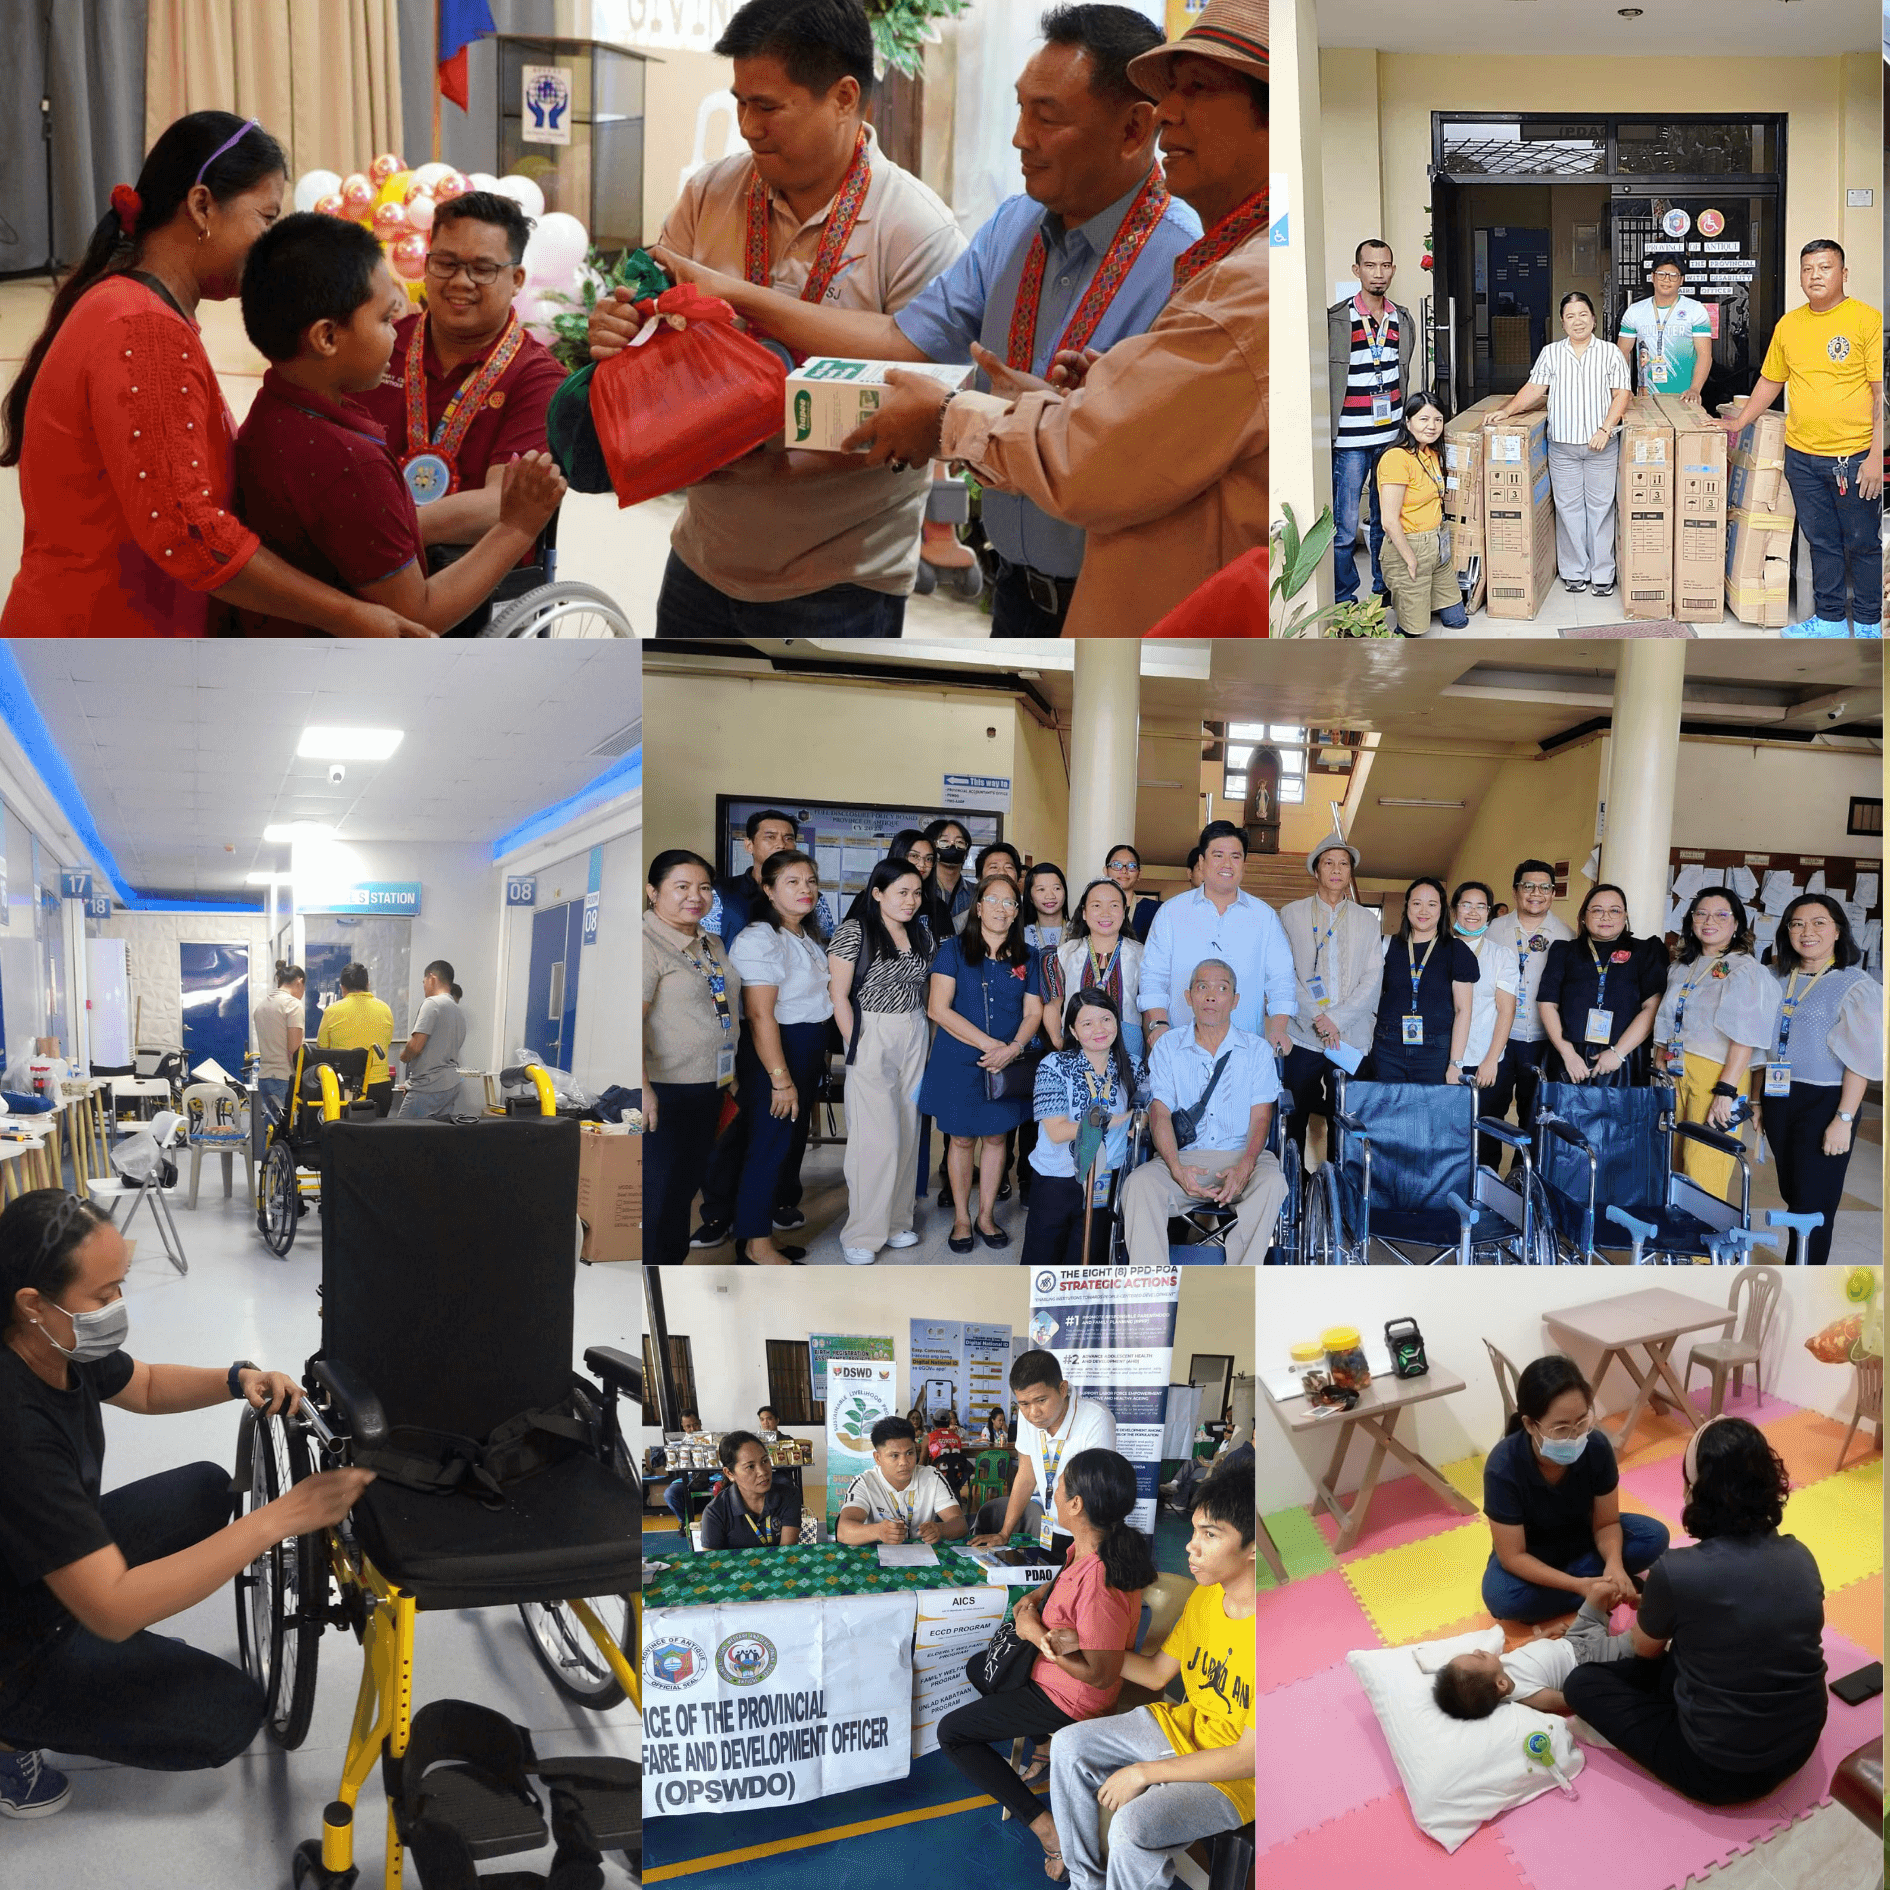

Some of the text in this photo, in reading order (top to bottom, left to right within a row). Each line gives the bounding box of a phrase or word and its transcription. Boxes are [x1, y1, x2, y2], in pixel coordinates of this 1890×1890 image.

[1646, 242, 1740, 251] PROVINCE OF ANTIQUE
[969, 777, 985, 786] This
[985, 779, 1000, 788] way
[69, 875, 86, 893] 17
[370, 892, 415, 905] STATION
[510, 883, 532, 901] 08
[91, 899, 106, 914] 18
[585, 908, 597, 933] 08
[1060, 1266, 1178, 1279] THE EIGHT (8) PPD-POA
[1059, 1276, 1178, 1292] STRATEGIC ACTIONS
[1065, 1315, 1079, 1327] #1
[1063, 1354, 1080, 1365] #2
[843, 1367, 872, 1378] DSWD
[849, 1389, 883, 1404] LIVELIHOOD
[832, 1394, 848, 1432] SUSTAINABLE
[1025, 1569, 1053, 1582] PDAO
[952, 1596, 976, 1606] AICS
[930, 1622, 991, 1637] ECCD PROGRAM
[680, 1638, 706, 1662] ANTIQUE
[930, 1673, 961, 1688] PROGRAM
[940, 1686, 972, 1703] KABATAAN
[676, 1703, 698, 1736] OF
[700, 1700, 734, 1734] THE
[737, 1690, 828, 1731] PROVINCIAL
[931, 1698, 961, 1714] PROGRAM
[685, 1740, 718, 1772] AND
[720, 1724, 829, 1771] DEVELOPMENT
[832, 1716, 889, 1755] OFFICER
[655, 1770, 796, 1814] (OPSWDO)
